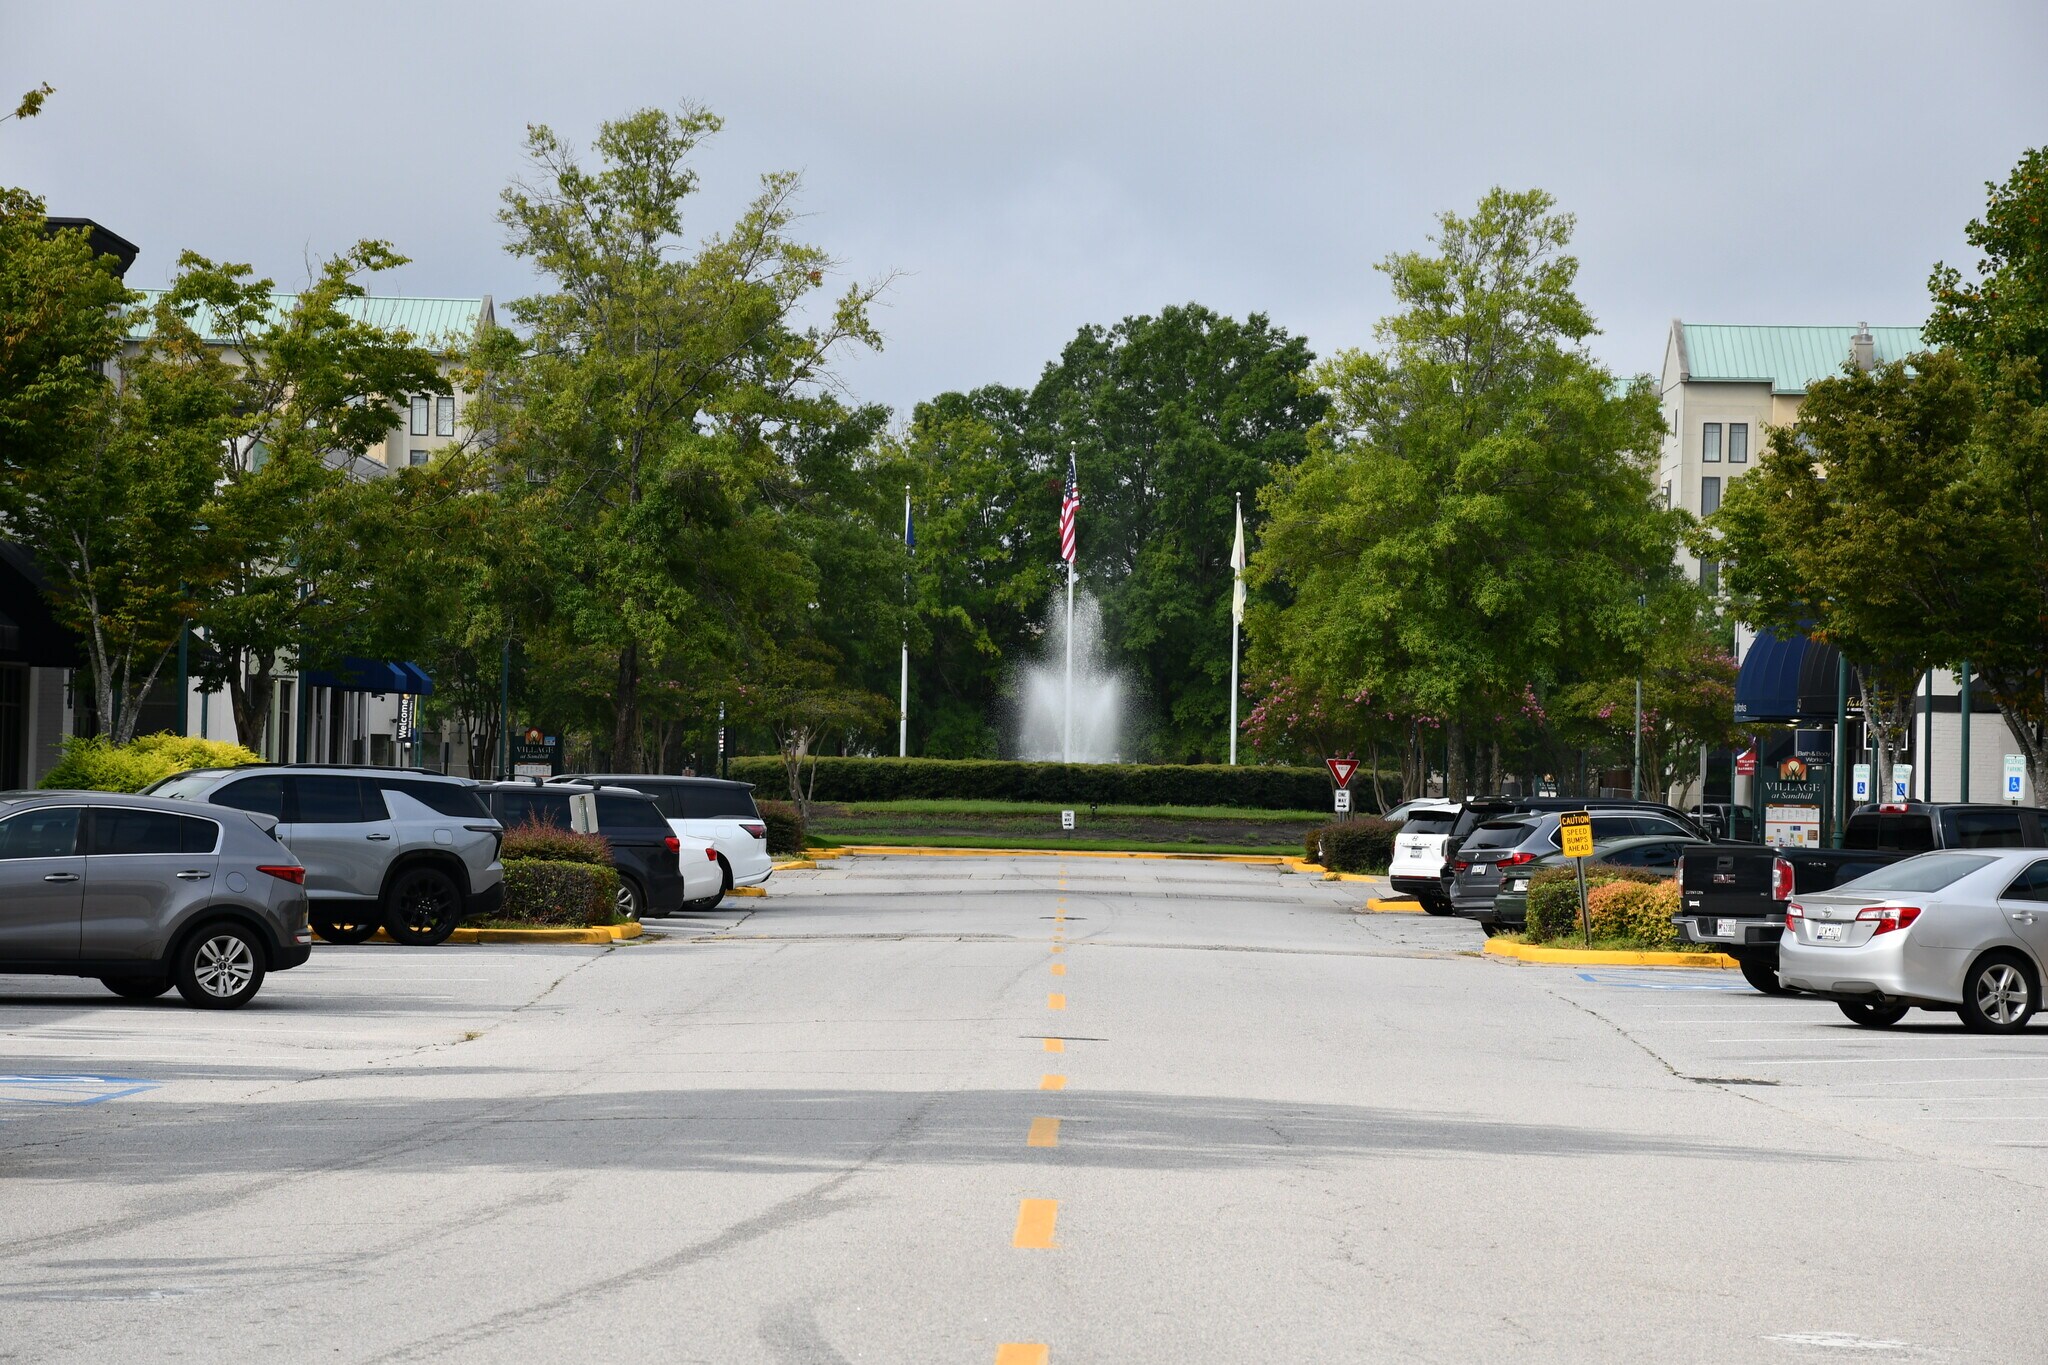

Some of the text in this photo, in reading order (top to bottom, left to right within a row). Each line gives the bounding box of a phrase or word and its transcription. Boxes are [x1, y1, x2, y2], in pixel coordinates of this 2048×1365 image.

[398, 699, 409, 739] Welcome
[1816, 750, 1831, 758] Body
[1765, 782, 1821, 792] VILLAGE
[1781, 792, 1813, 800] Sandhill
[1562, 815, 1589, 825] CAUTION
[1567, 828, 1588, 836] SPEED
[1567, 836, 1589, 845] BUMPS
[1569, 844, 1589, 852] AHEAD
